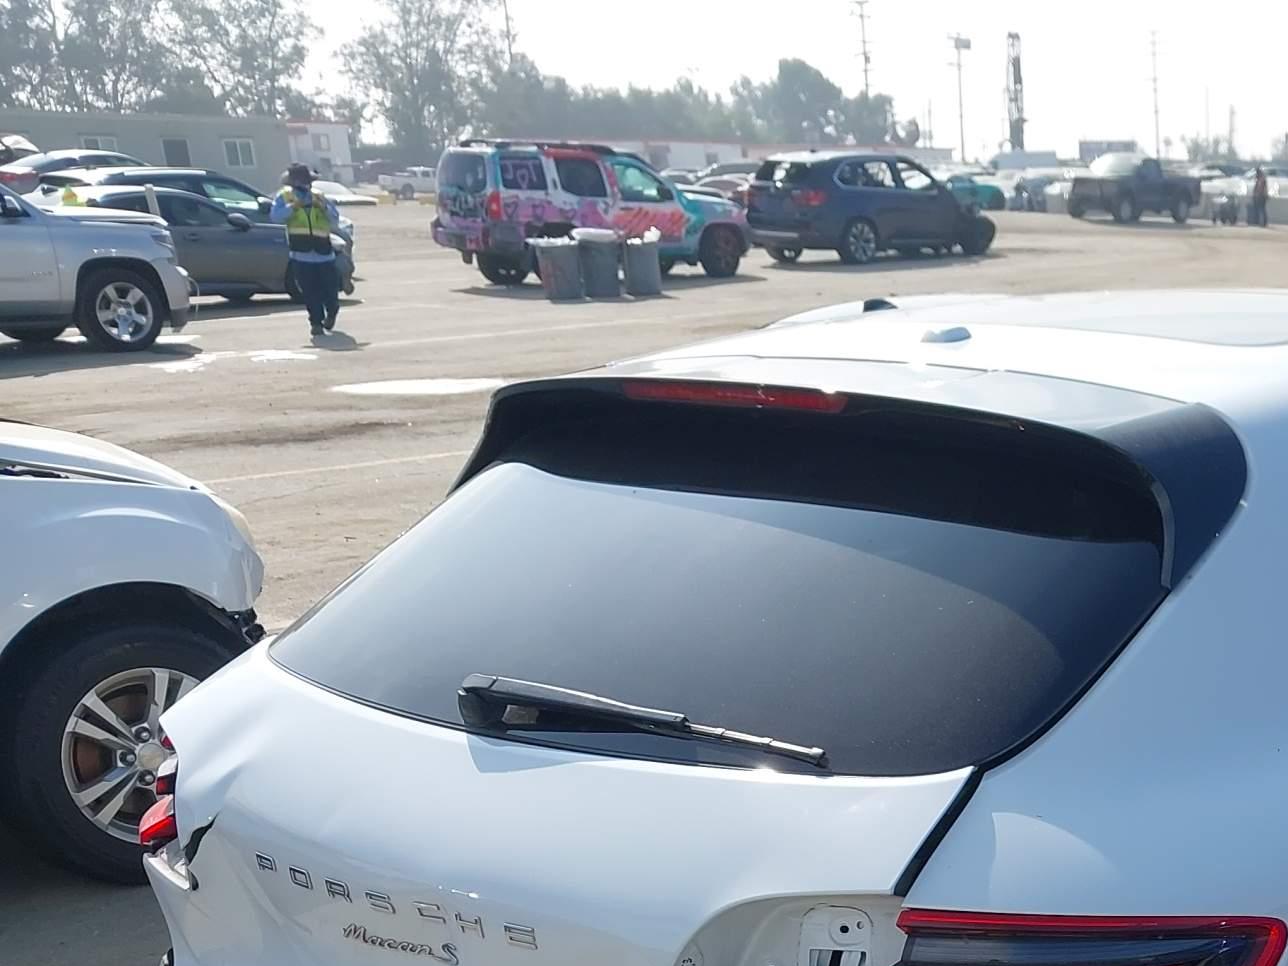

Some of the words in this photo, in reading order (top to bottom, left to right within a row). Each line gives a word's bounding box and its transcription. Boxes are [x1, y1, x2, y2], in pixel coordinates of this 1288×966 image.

[255, 851, 538, 949] PORSCHE
[343, 923, 434, 955] Macan
[438, 943, 459, 966] S
